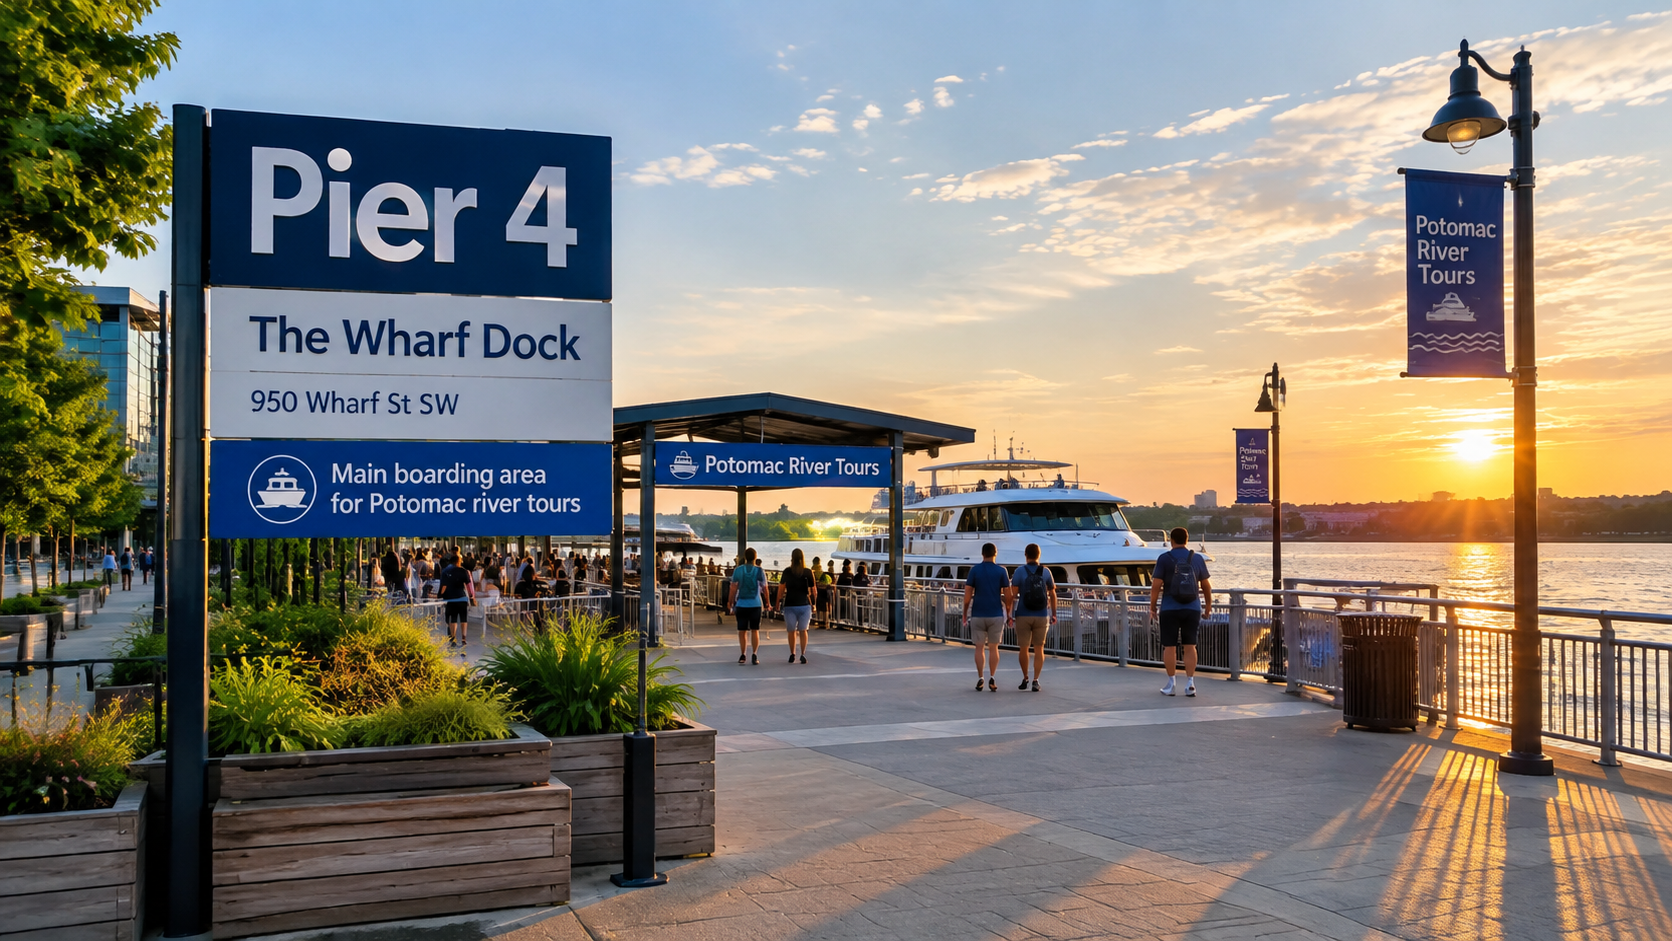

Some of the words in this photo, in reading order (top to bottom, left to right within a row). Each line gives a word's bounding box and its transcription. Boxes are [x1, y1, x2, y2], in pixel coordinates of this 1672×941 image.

[250, 145, 478, 264] Pier
[505, 165, 578, 268] 4
[1416, 214, 1497, 239] Potomac
[1417, 239, 1469, 262] River
[1417, 263, 1476, 285] Tours
[249, 315, 330, 355] The
[342, 318, 471, 358] Wharf
[483, 323, 581, 361] Dock
[250, 389, 298, 413] 950
[305, 390, 380, 415] Wharf
[387, 393, 412, 415] St
[419, 393, 459, 416] SW
[331, 462, 387, 485] Main
[394, 462, 494, 490] boarding
[499, 468, 547, 485] area
[705, 454, 784, 475] Potomac
[789, 456, 832, 475] River
[836, 457, 880, 476] Tours
[330, 491, 363, 514] for
[370, 492, 467, 514] Potomac
[473, 491, 522, 513] river
[527, 494, 581, 513] tours
